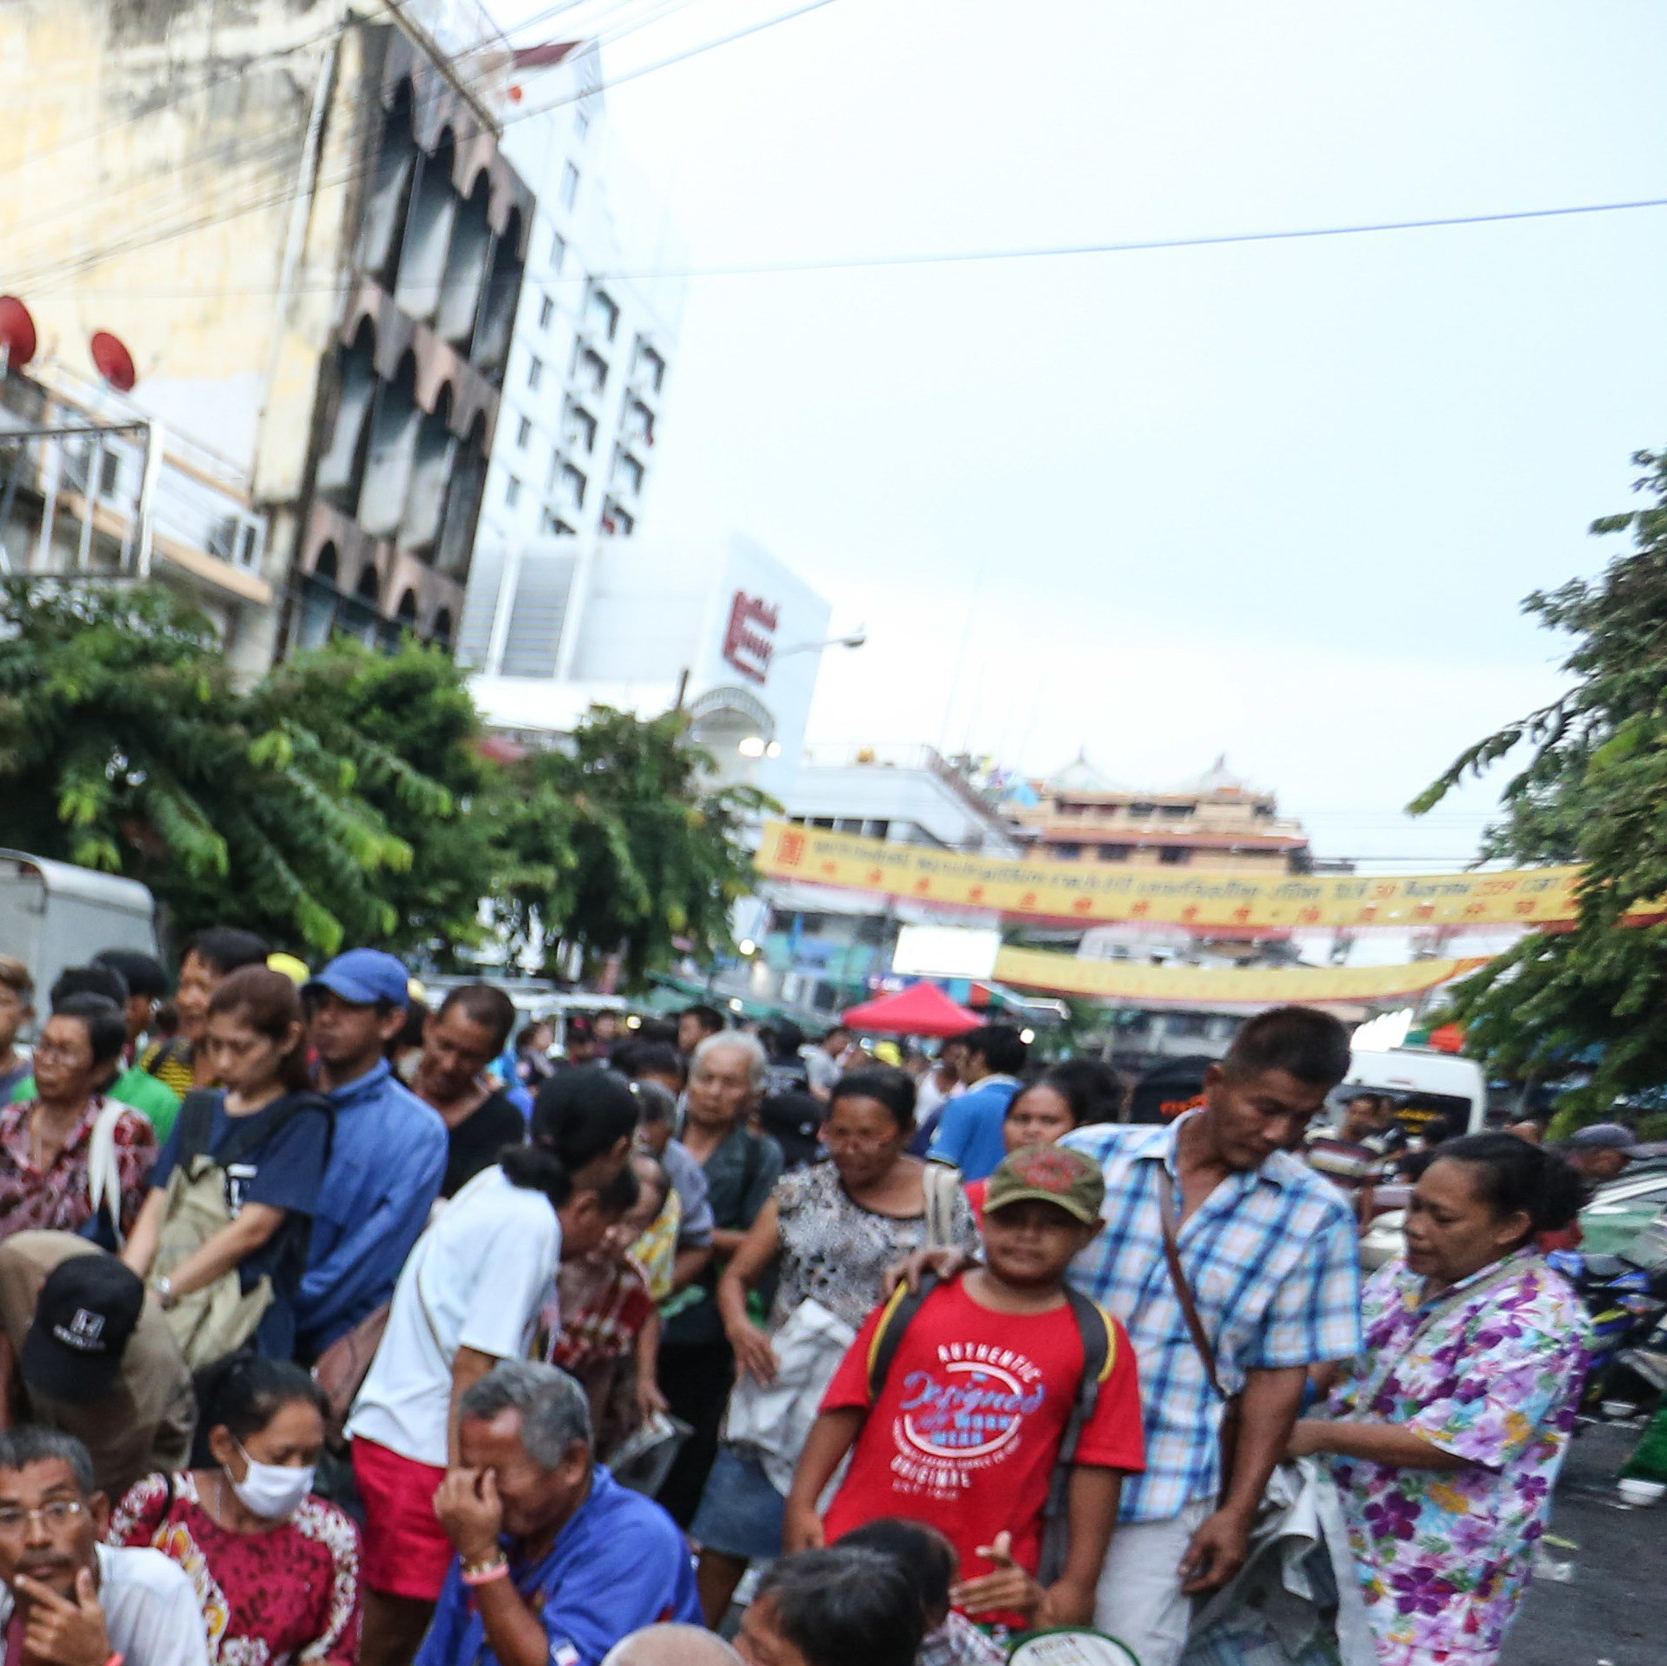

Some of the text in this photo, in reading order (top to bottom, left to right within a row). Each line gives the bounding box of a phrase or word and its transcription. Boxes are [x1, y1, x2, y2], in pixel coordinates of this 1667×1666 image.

[937, 1341, 1042, 1384] AUTHENTIC
[900, 1371, 1046, 1417] Designed
[890, 1453, 972, 1488] ORIGINAL
